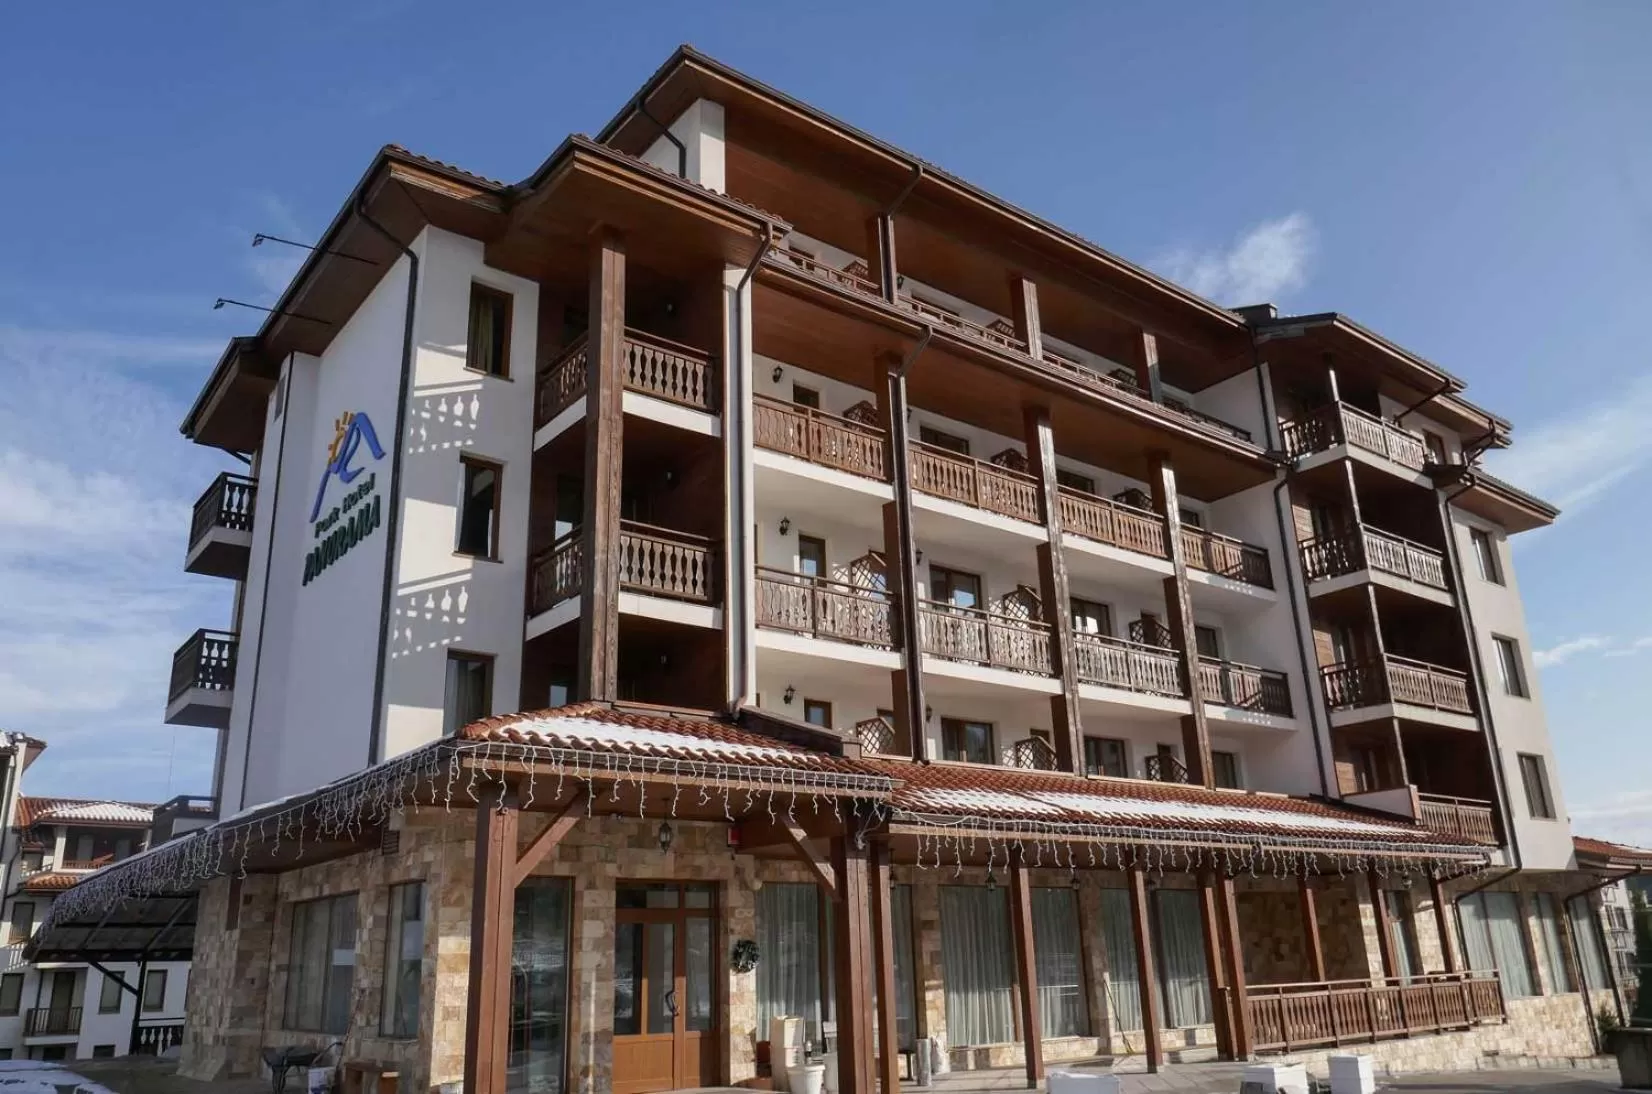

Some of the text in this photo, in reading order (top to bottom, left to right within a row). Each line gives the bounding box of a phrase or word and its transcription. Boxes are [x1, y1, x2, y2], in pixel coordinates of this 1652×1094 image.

[302, 494, 381, 587] PANORAMA
[315, 472, 376, 538] Park Hotel
